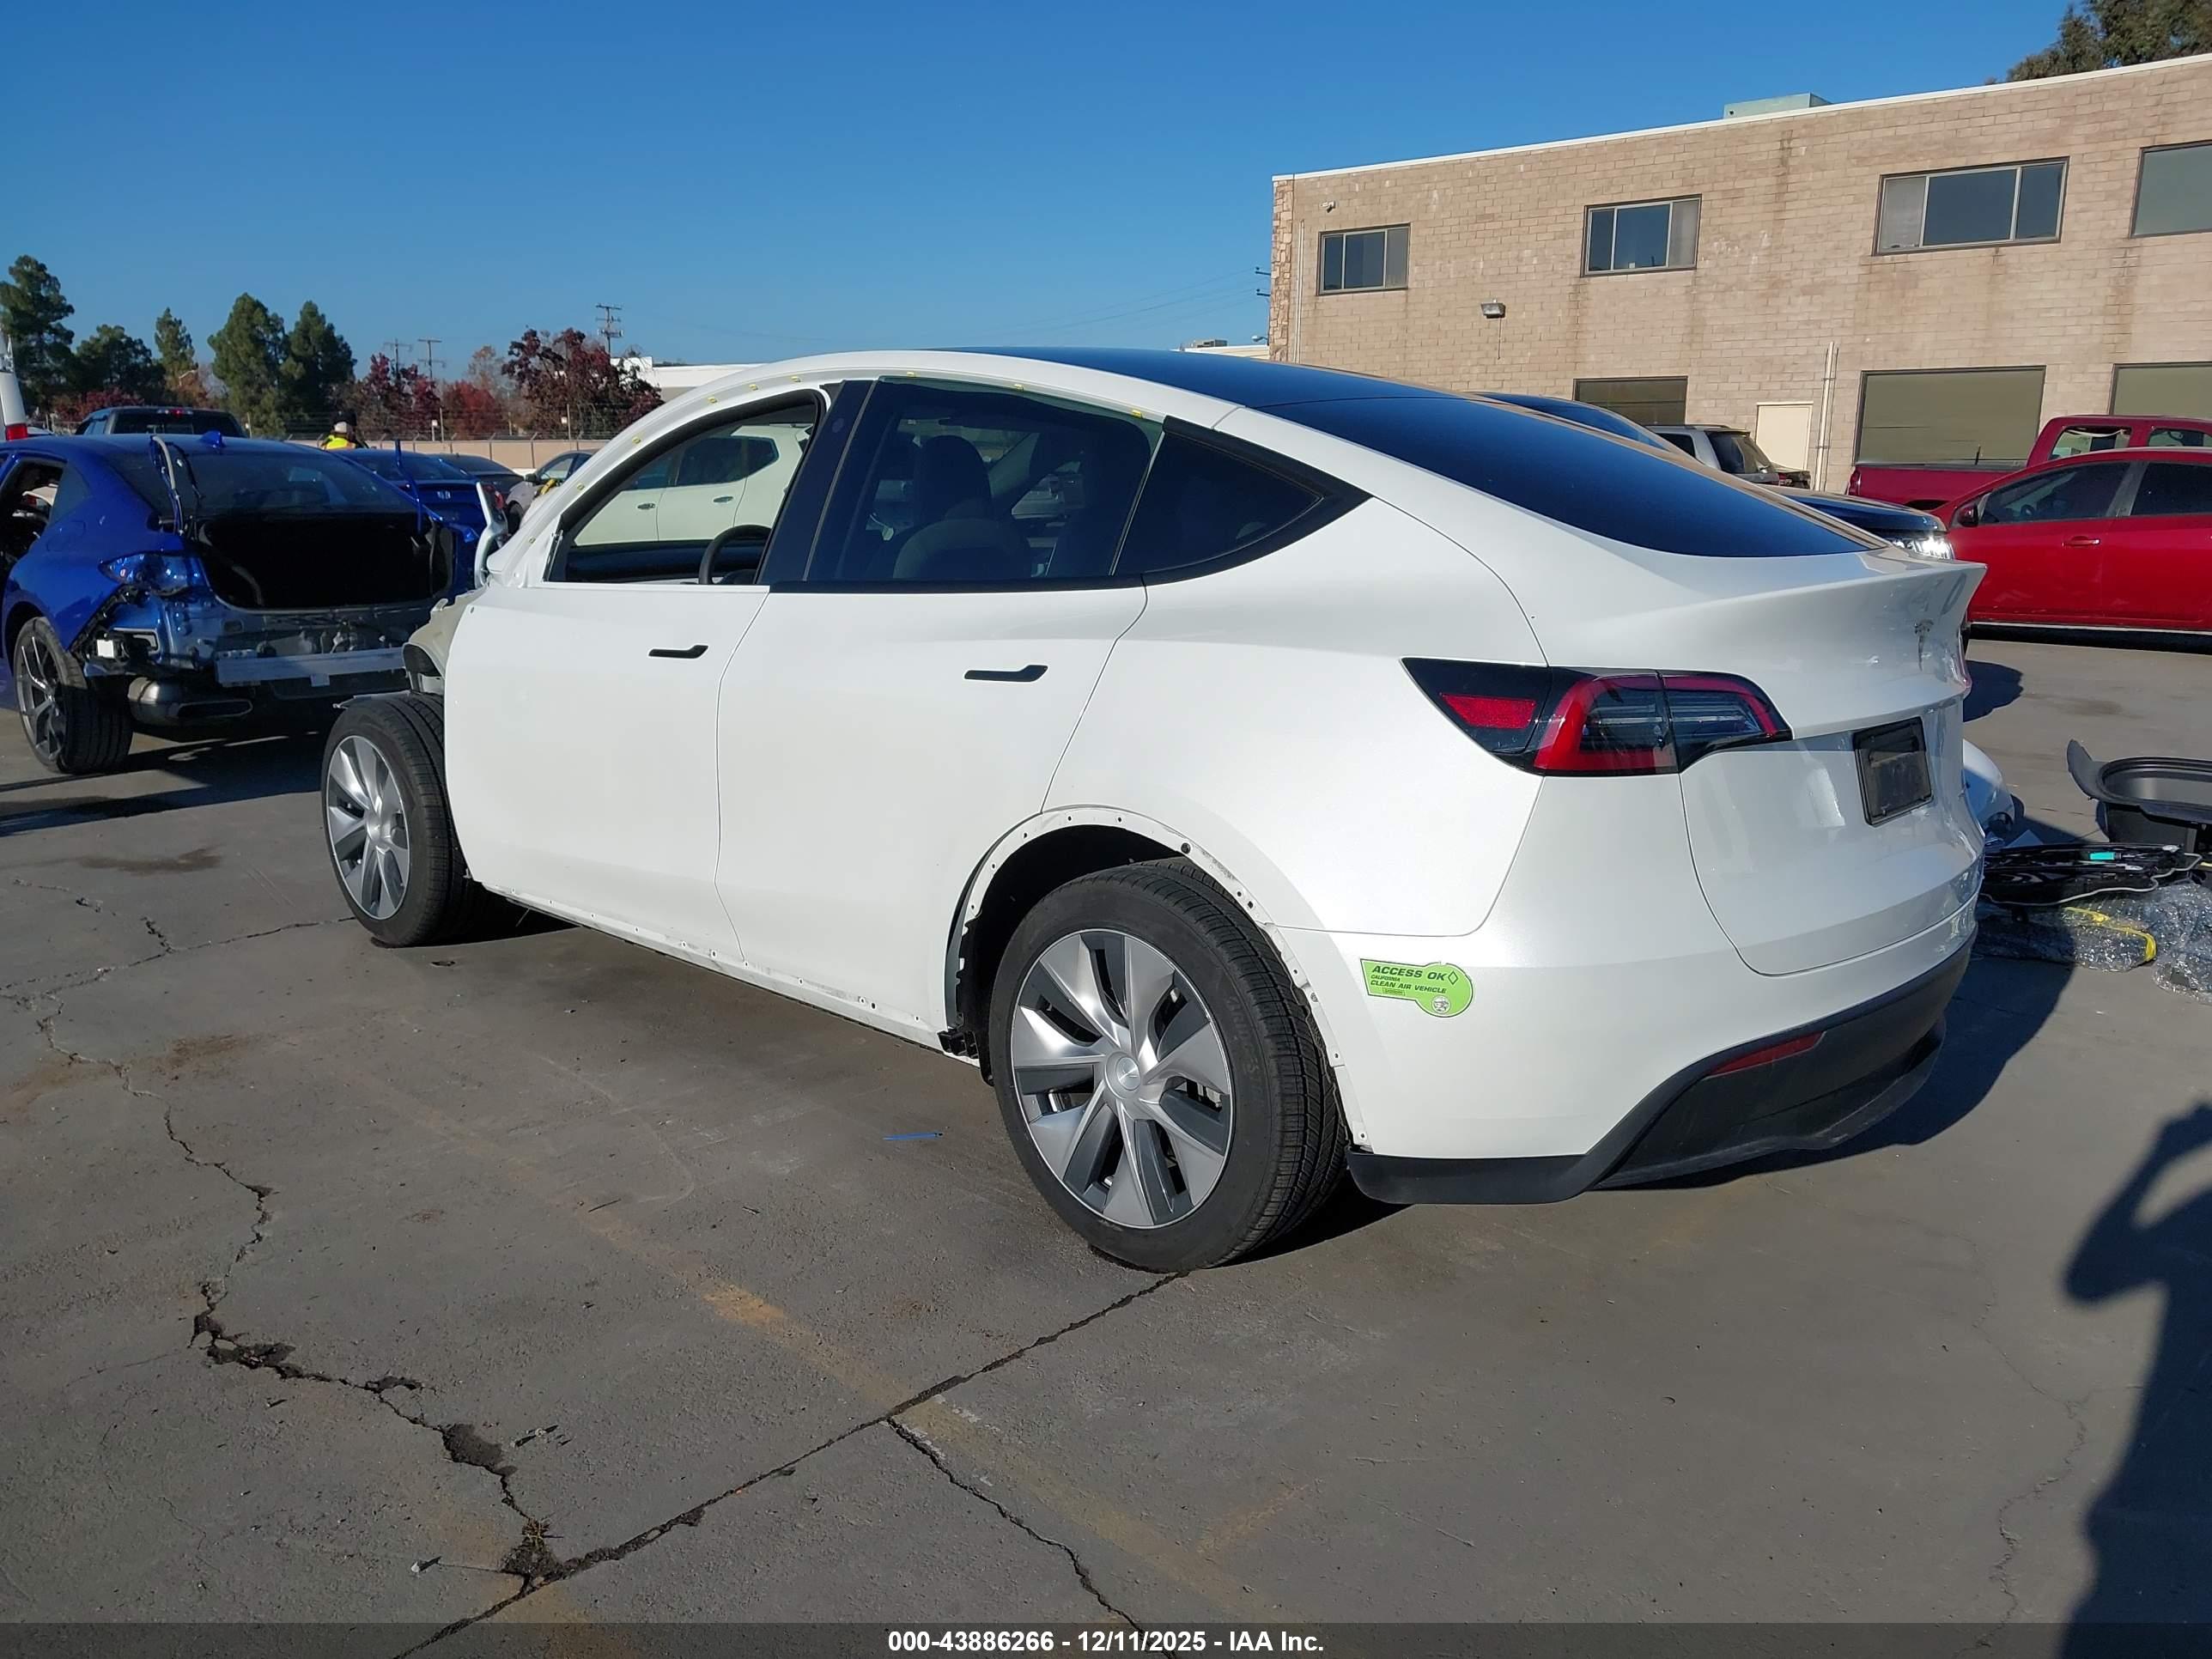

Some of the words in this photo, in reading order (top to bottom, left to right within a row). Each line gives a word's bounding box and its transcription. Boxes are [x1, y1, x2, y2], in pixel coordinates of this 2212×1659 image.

[1372, 966, 1423, 978] ACCESS
[1427, 971, 1448, 981] OK
[1414, 985, 1447, 994] VEHICLE
